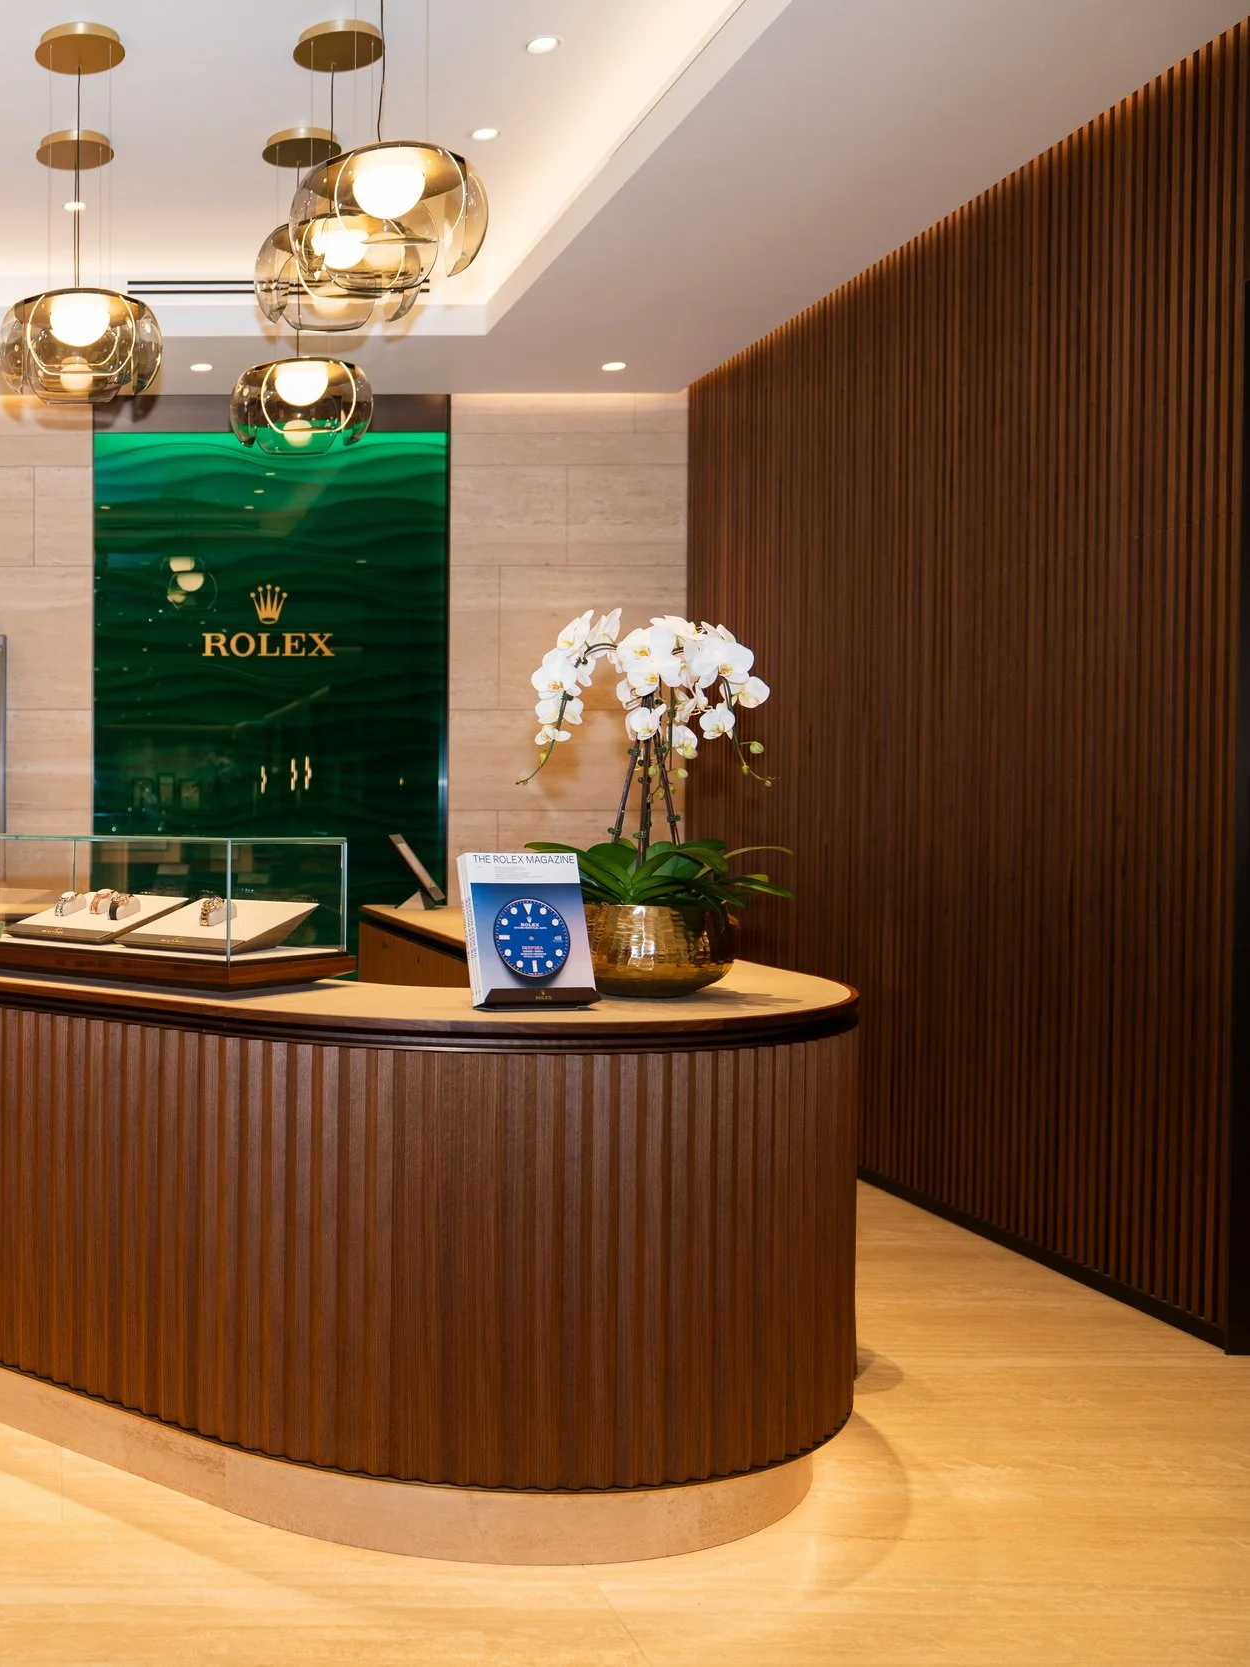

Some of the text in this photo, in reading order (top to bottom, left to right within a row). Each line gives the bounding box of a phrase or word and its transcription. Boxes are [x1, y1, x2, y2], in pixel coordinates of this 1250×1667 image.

[201, 632, 335, 657] ROLEX
[473, 854, 575, 865] THE ROLEX MAGAZINE
